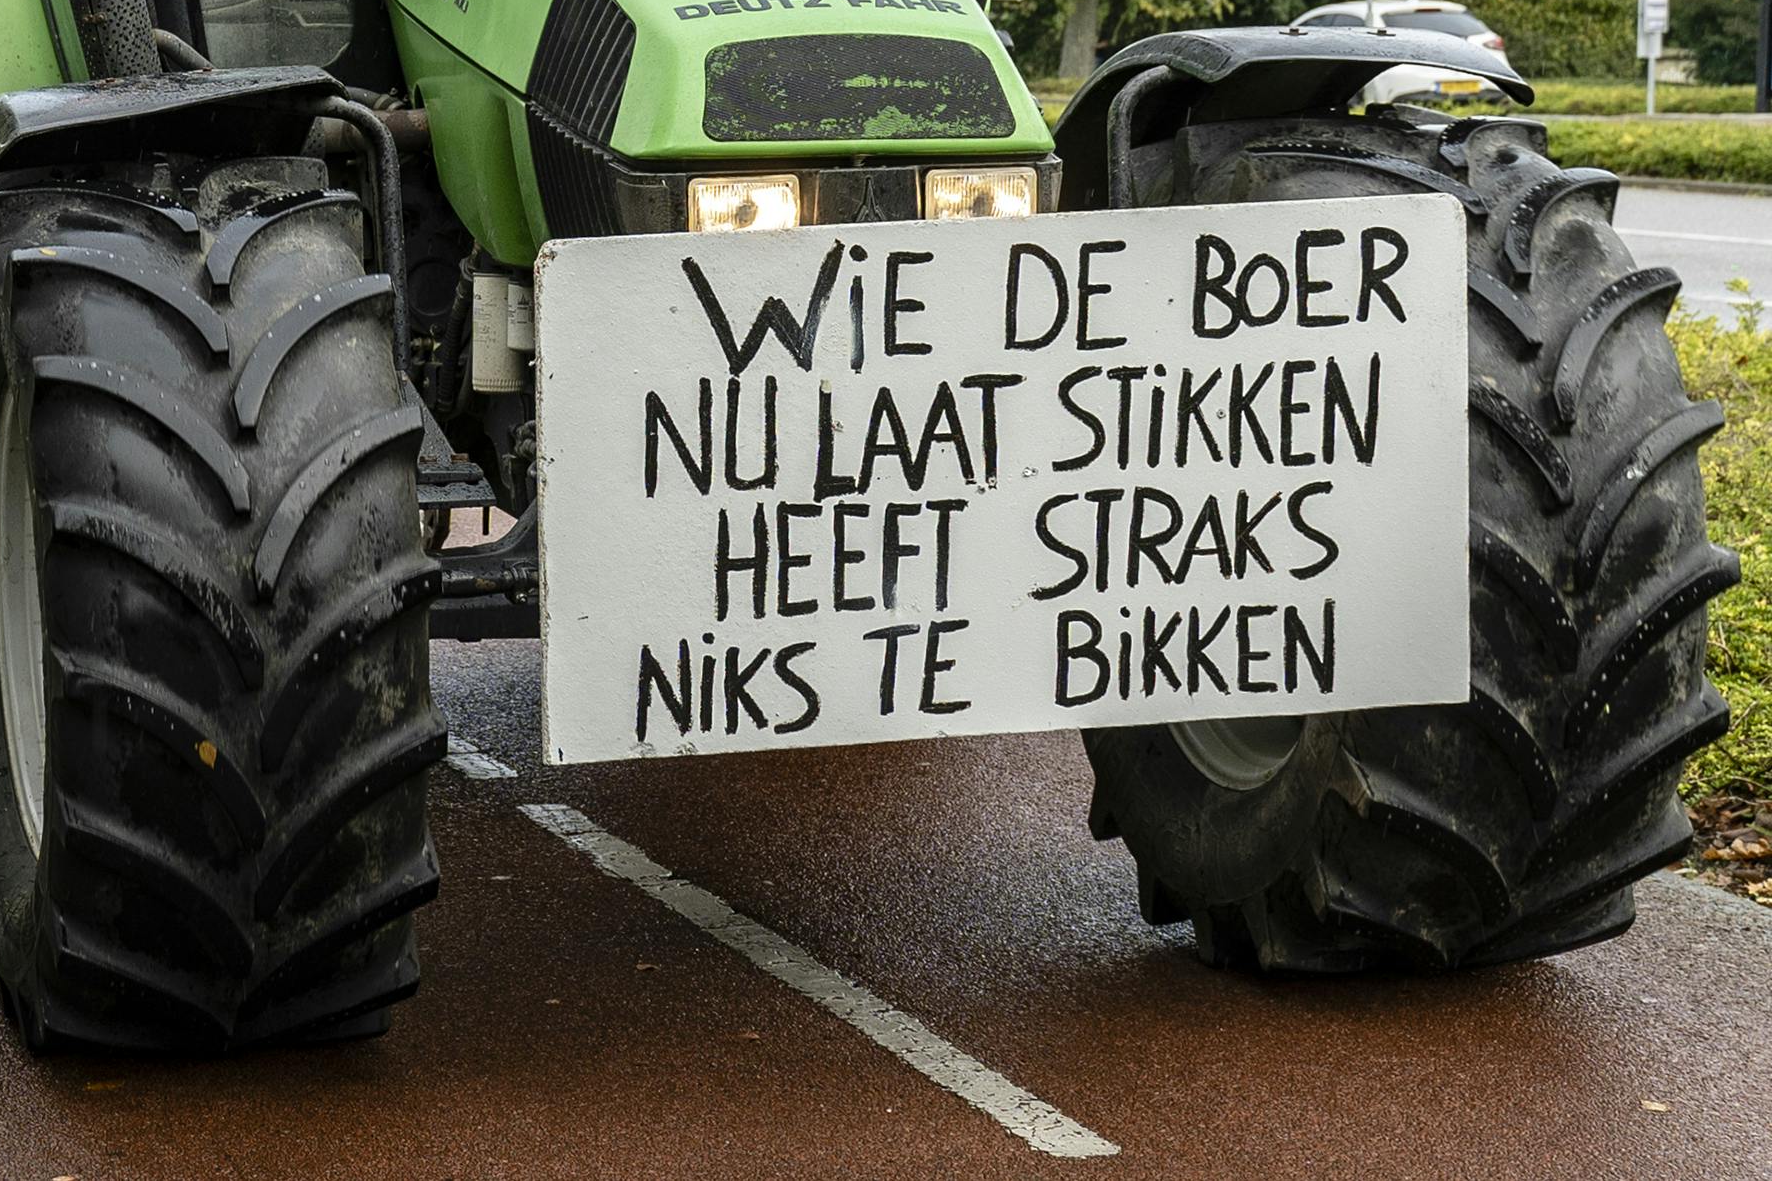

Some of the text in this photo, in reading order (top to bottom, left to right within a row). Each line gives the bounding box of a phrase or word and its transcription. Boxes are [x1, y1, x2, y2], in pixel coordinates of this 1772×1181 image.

[1005, 241, 1127, 351] DE
[1192, 227, 1408, 339] BOER
[645, 376, 777, 498] NU
[813, 374, 1023, 502] LAAT
[714, 481, 1339, 623] HEEFT STRAKS
[863, 620, 971, 715] TE
